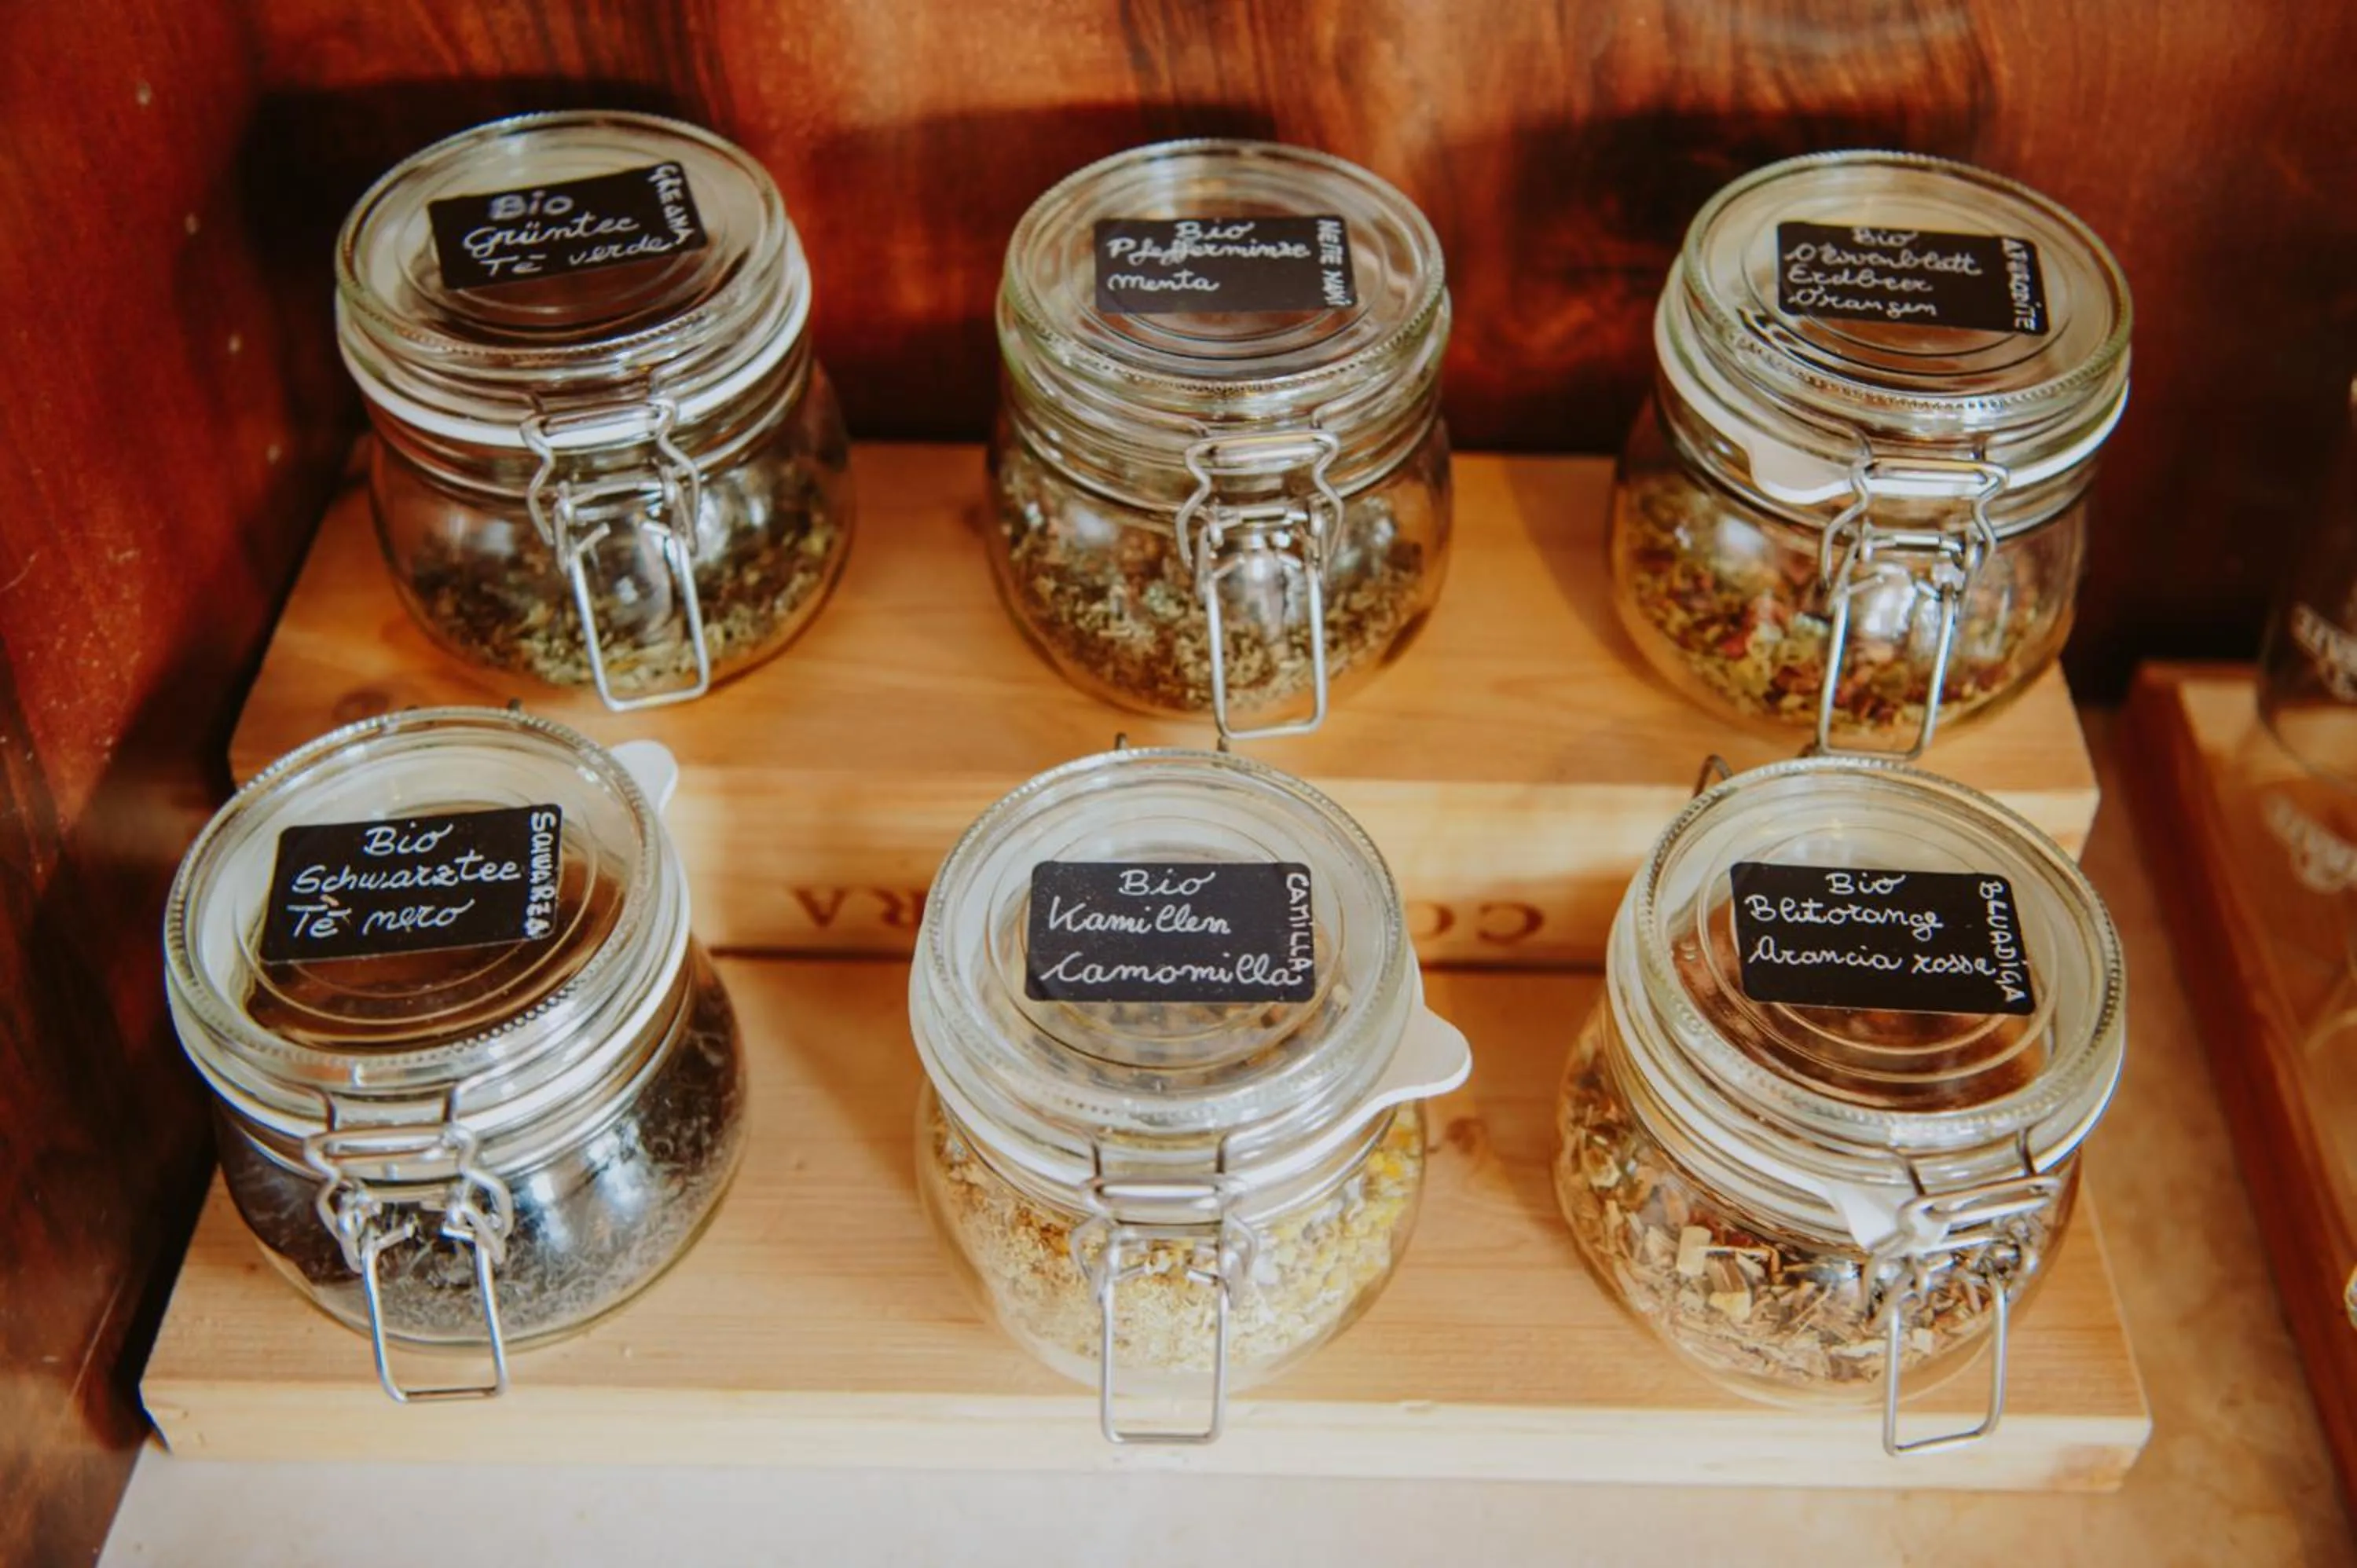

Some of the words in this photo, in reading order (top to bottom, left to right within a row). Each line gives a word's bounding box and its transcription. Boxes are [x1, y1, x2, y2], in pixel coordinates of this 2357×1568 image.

[489, 190, 574, 221] Bio
[1174, 217, 1255, 240] Bio
[1853, 225, 1919, 246] Bio
[363, 822, 454, 856] Bio
[291, 849, 522, 894] Schwarztee
[1118, 868, 1216, 896] Bio
[1824, 872, 1907, 896] Bio
[362, 899, 475, 936] nero
[1047, 895, 1232, 935] Kamillen
[1039, 951, 1303, 987] Camomilla
[1748, 935, 1903, 971] Arancia
